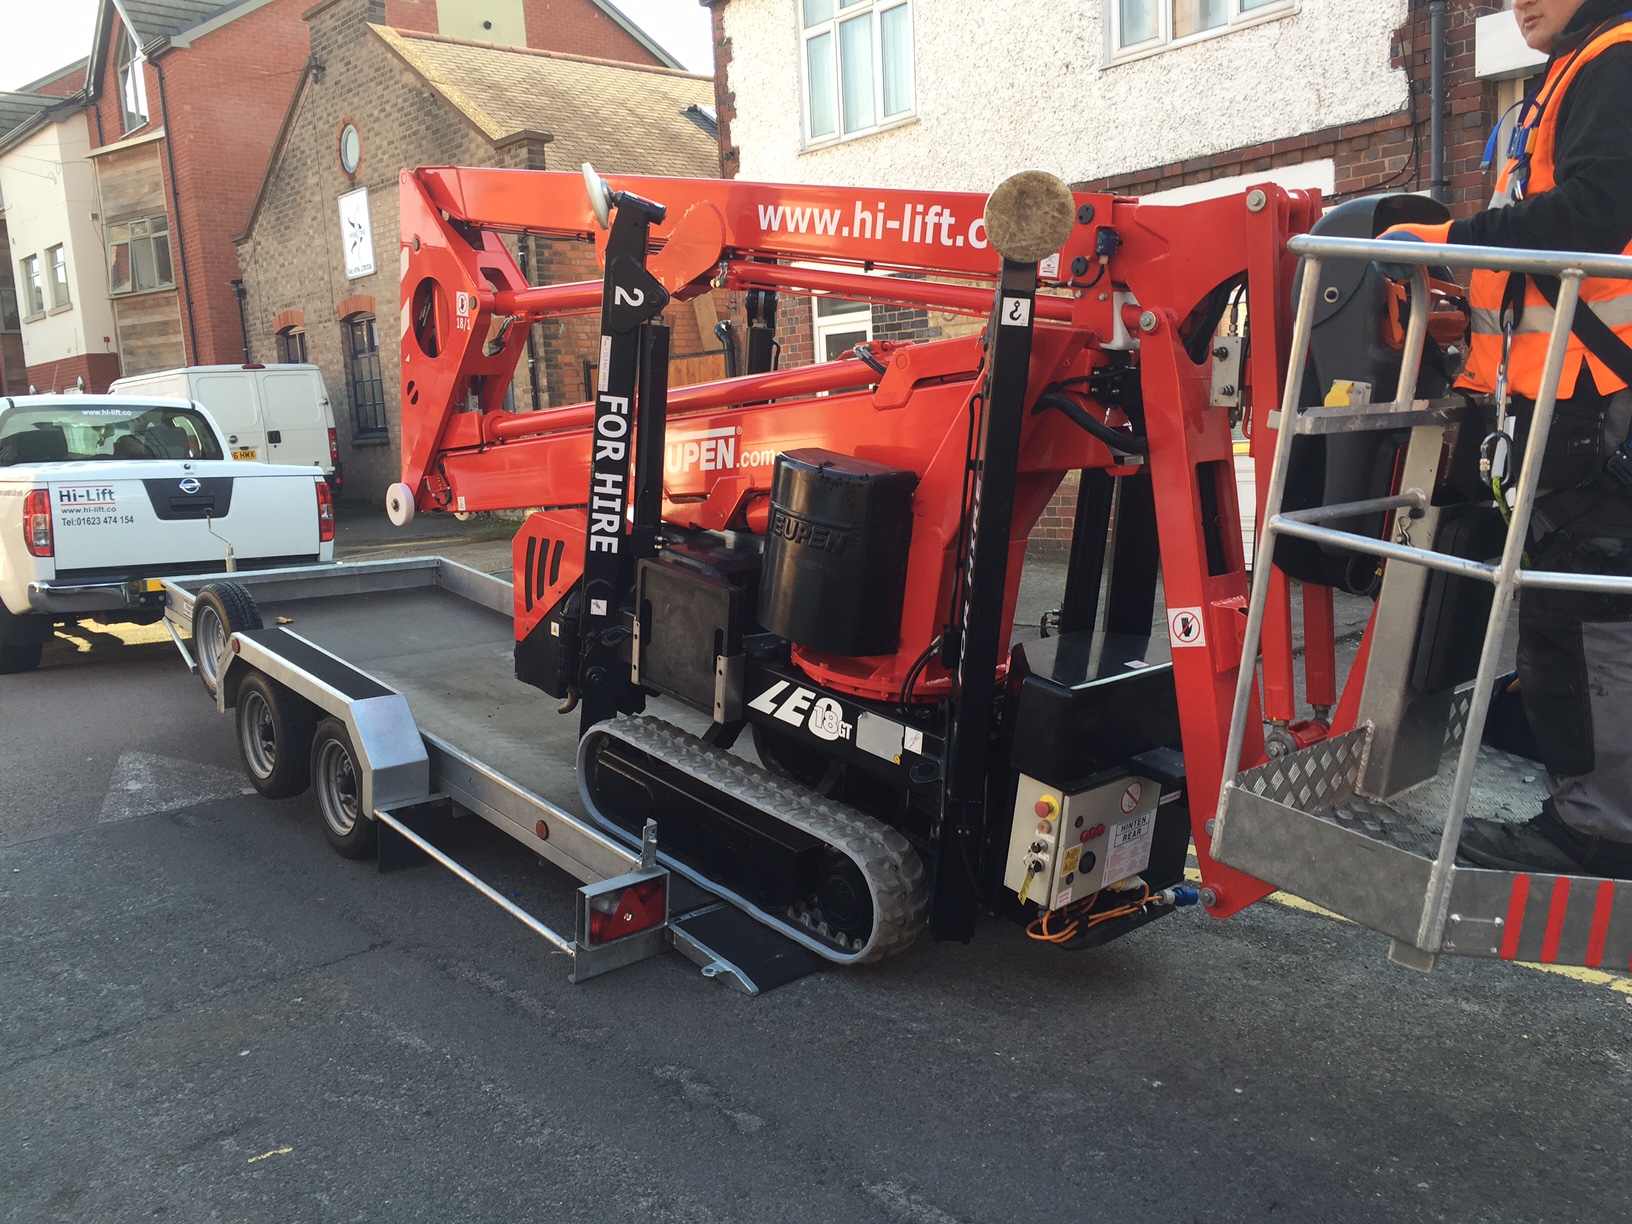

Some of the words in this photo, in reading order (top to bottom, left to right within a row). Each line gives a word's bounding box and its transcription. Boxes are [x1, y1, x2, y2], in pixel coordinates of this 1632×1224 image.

[757, 200, 988, 249] www.hi-lift.c
[614, 285, 645, 307] 2
[595, 394, 629, 462] FOR
[59, 488, 116, 502] Hi-Lift
[60, 506, 117, 514] www.hi-lift.co
[590, 472, 624, 555] HIRE
[61, 516, 101, 526] Tel:01623
[103, 516, 118, 525] 474
[120, 515, 134, 524] 154
[1121, 816, 1147, 832] HINTEN
[1122, 828, 1142, 842] REAR
